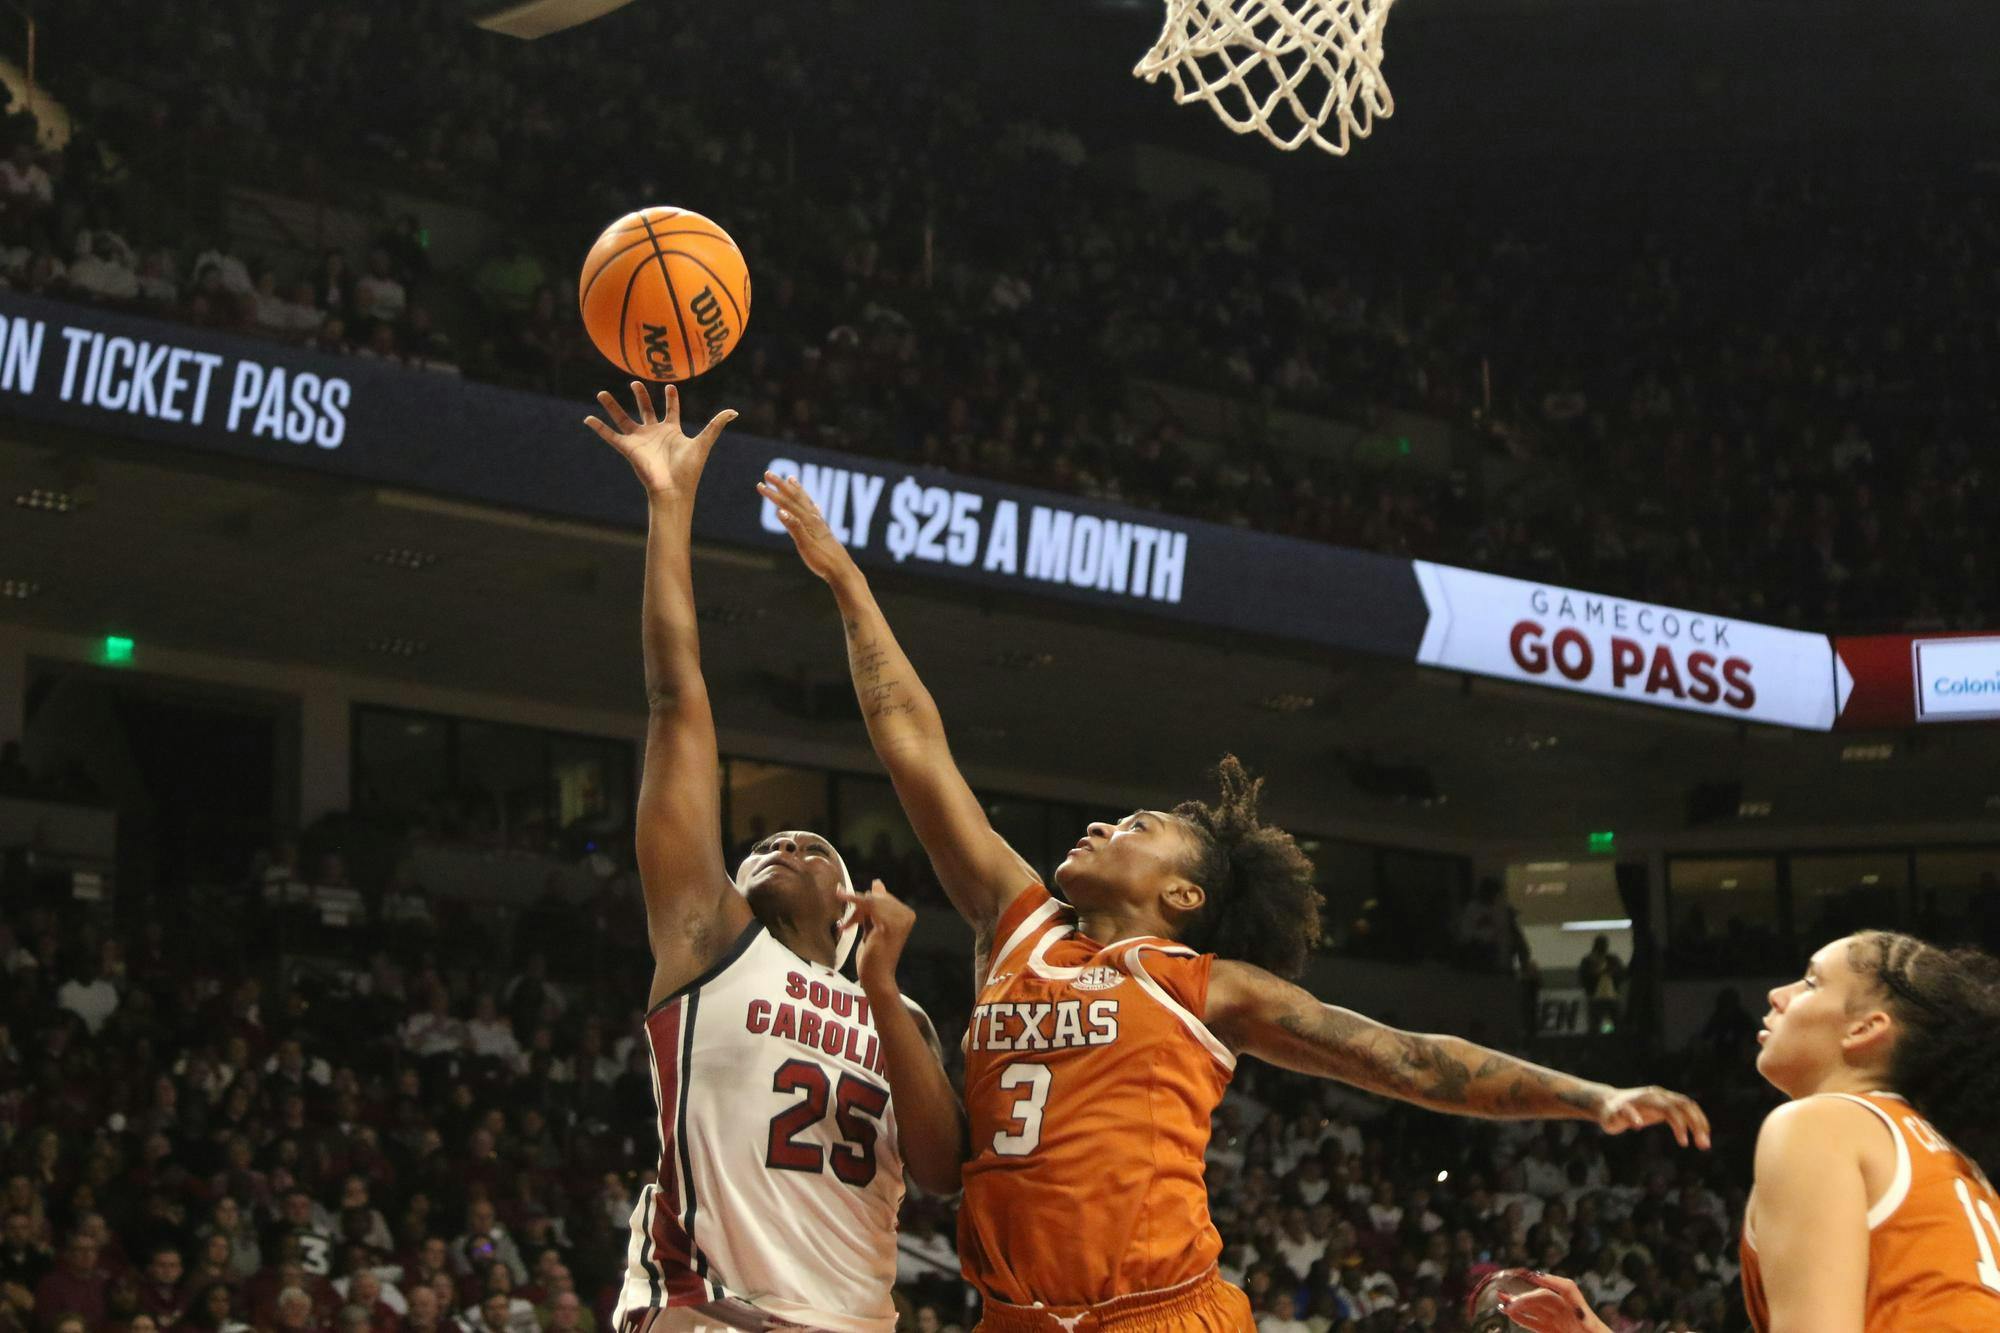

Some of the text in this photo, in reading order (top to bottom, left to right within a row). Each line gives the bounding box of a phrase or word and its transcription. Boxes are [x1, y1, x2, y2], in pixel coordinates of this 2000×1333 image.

[59, 326, 223, 425] TICKET
[226, 360, 351, 449] PASS
[761, 457, 1188, 603] ONLY $25 A MONTH
[1531, 589, 1731, 648] GAMECOCK
[1509, 620, 1756, 710] GO PASS
[785, 971, 873, 1026] SOUT
[972, 1000, 1119, 1050] TEXAS
[765, 1057, 890, 1188] 25
[992, 1063, 1053, 1156] 3
[299, 1236, 329, 1275] 3
